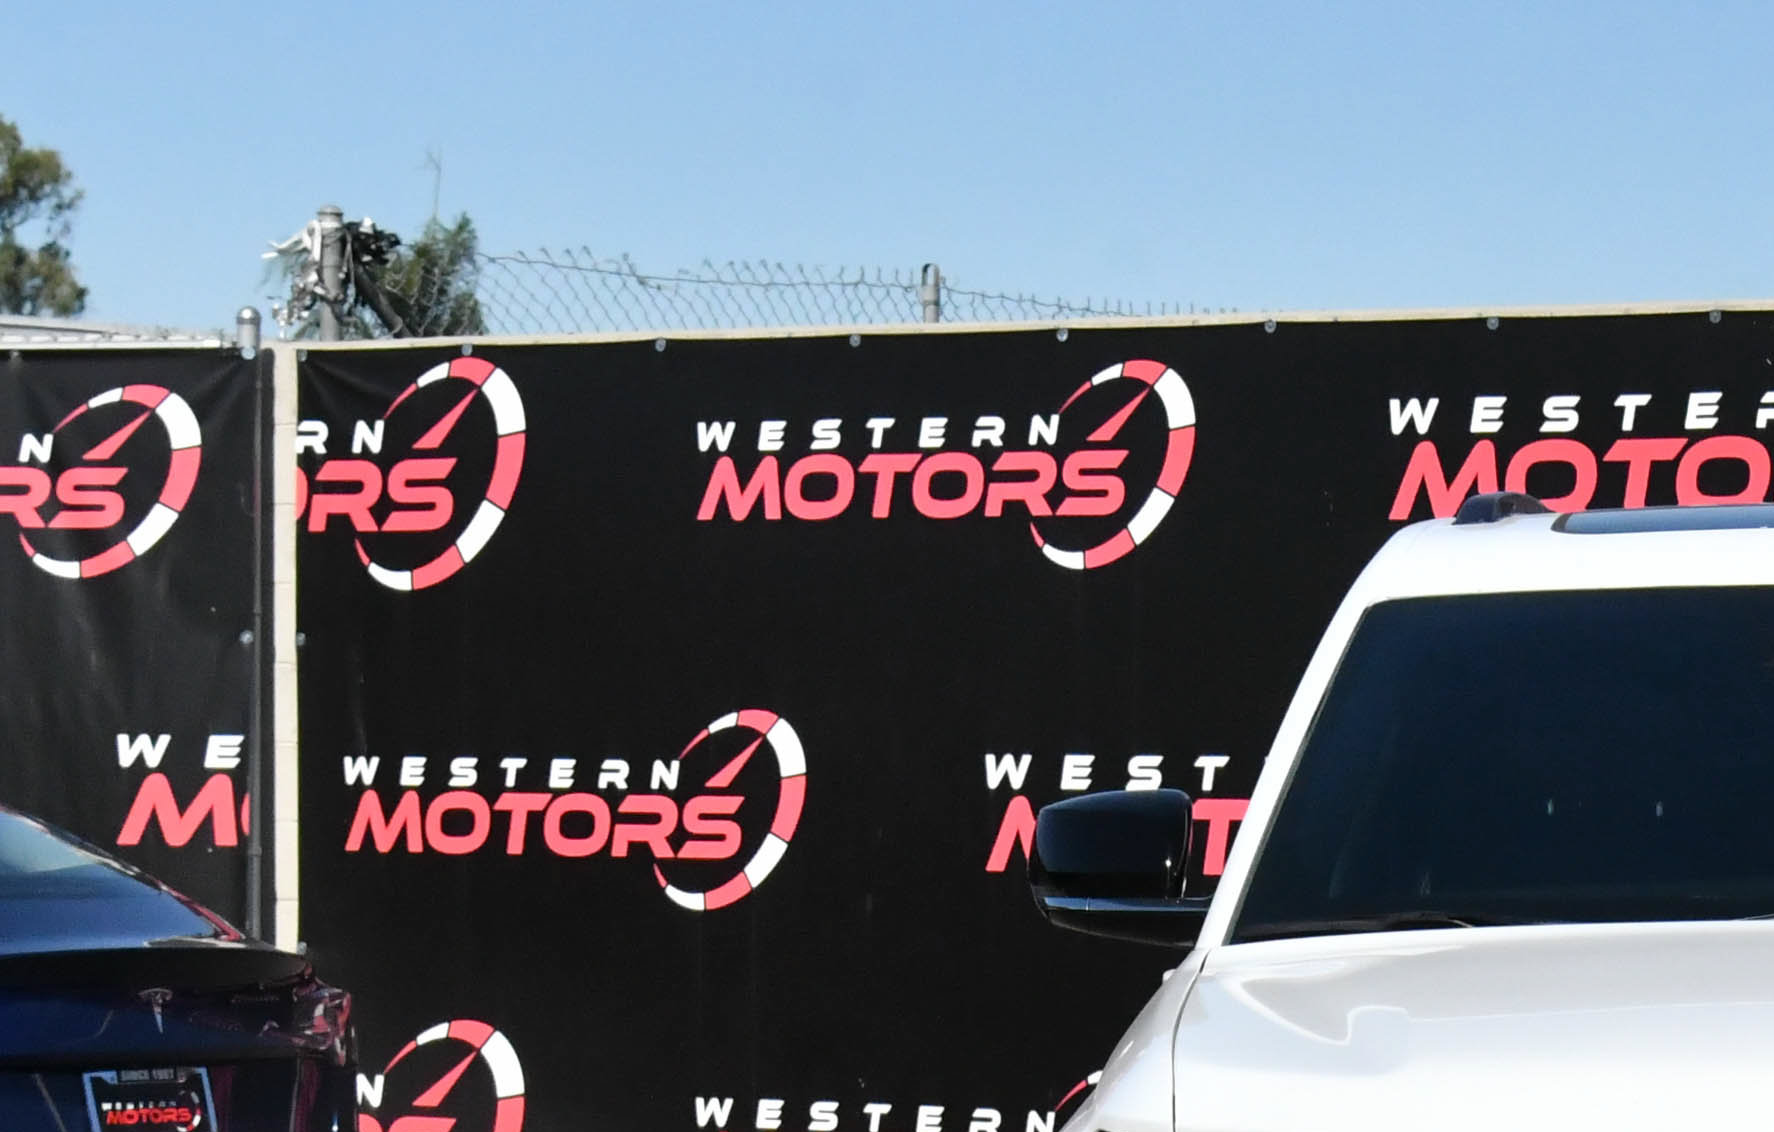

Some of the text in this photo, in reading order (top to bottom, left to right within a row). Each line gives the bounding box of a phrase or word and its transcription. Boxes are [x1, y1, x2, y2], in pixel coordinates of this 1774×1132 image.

[697, 413, 1060, 452] WESTERN
[296, 457, 458, 532] RS
[696, 448, 1130, 522] MOTORS
[343, 755, 680, 790] WESTERN
[116, 772, 250, 847] M
[344, 788, 745, 859] MOTORS
[106, 1107, 193, 1125] MOTORS
